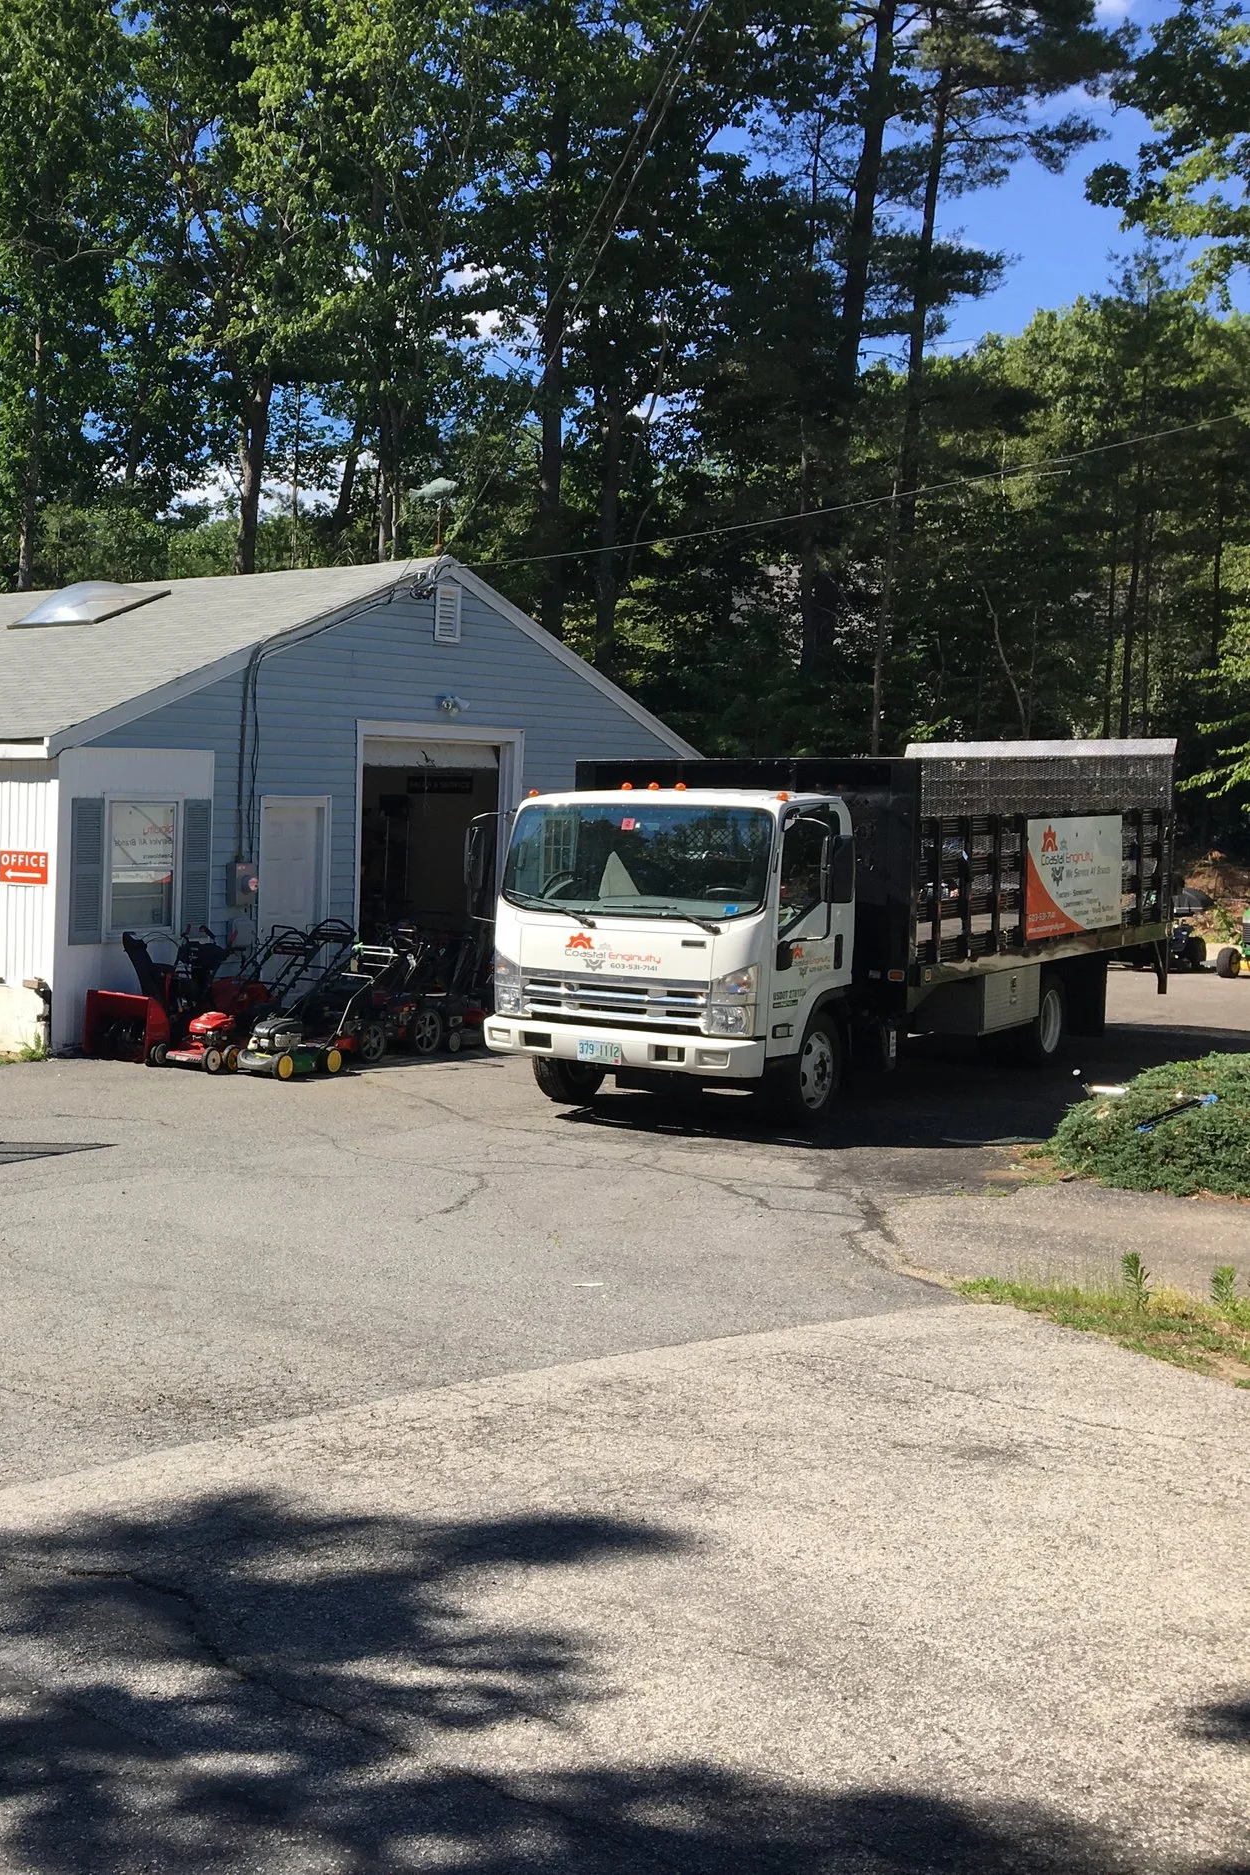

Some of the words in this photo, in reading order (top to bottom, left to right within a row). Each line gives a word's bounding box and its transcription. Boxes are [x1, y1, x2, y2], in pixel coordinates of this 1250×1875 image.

[1, 853, 46, 868] OFFICE
[1041, 853, 1064, 866] Coastal
[564, 949, 606, 959] Coastal
[608, 952, 662, 964] Enginuity
[610, 963, 658, 972] 603-531-7141
[579, 1042, 595, 1055] 379
[600, 1044, 620, 1058] 1112
